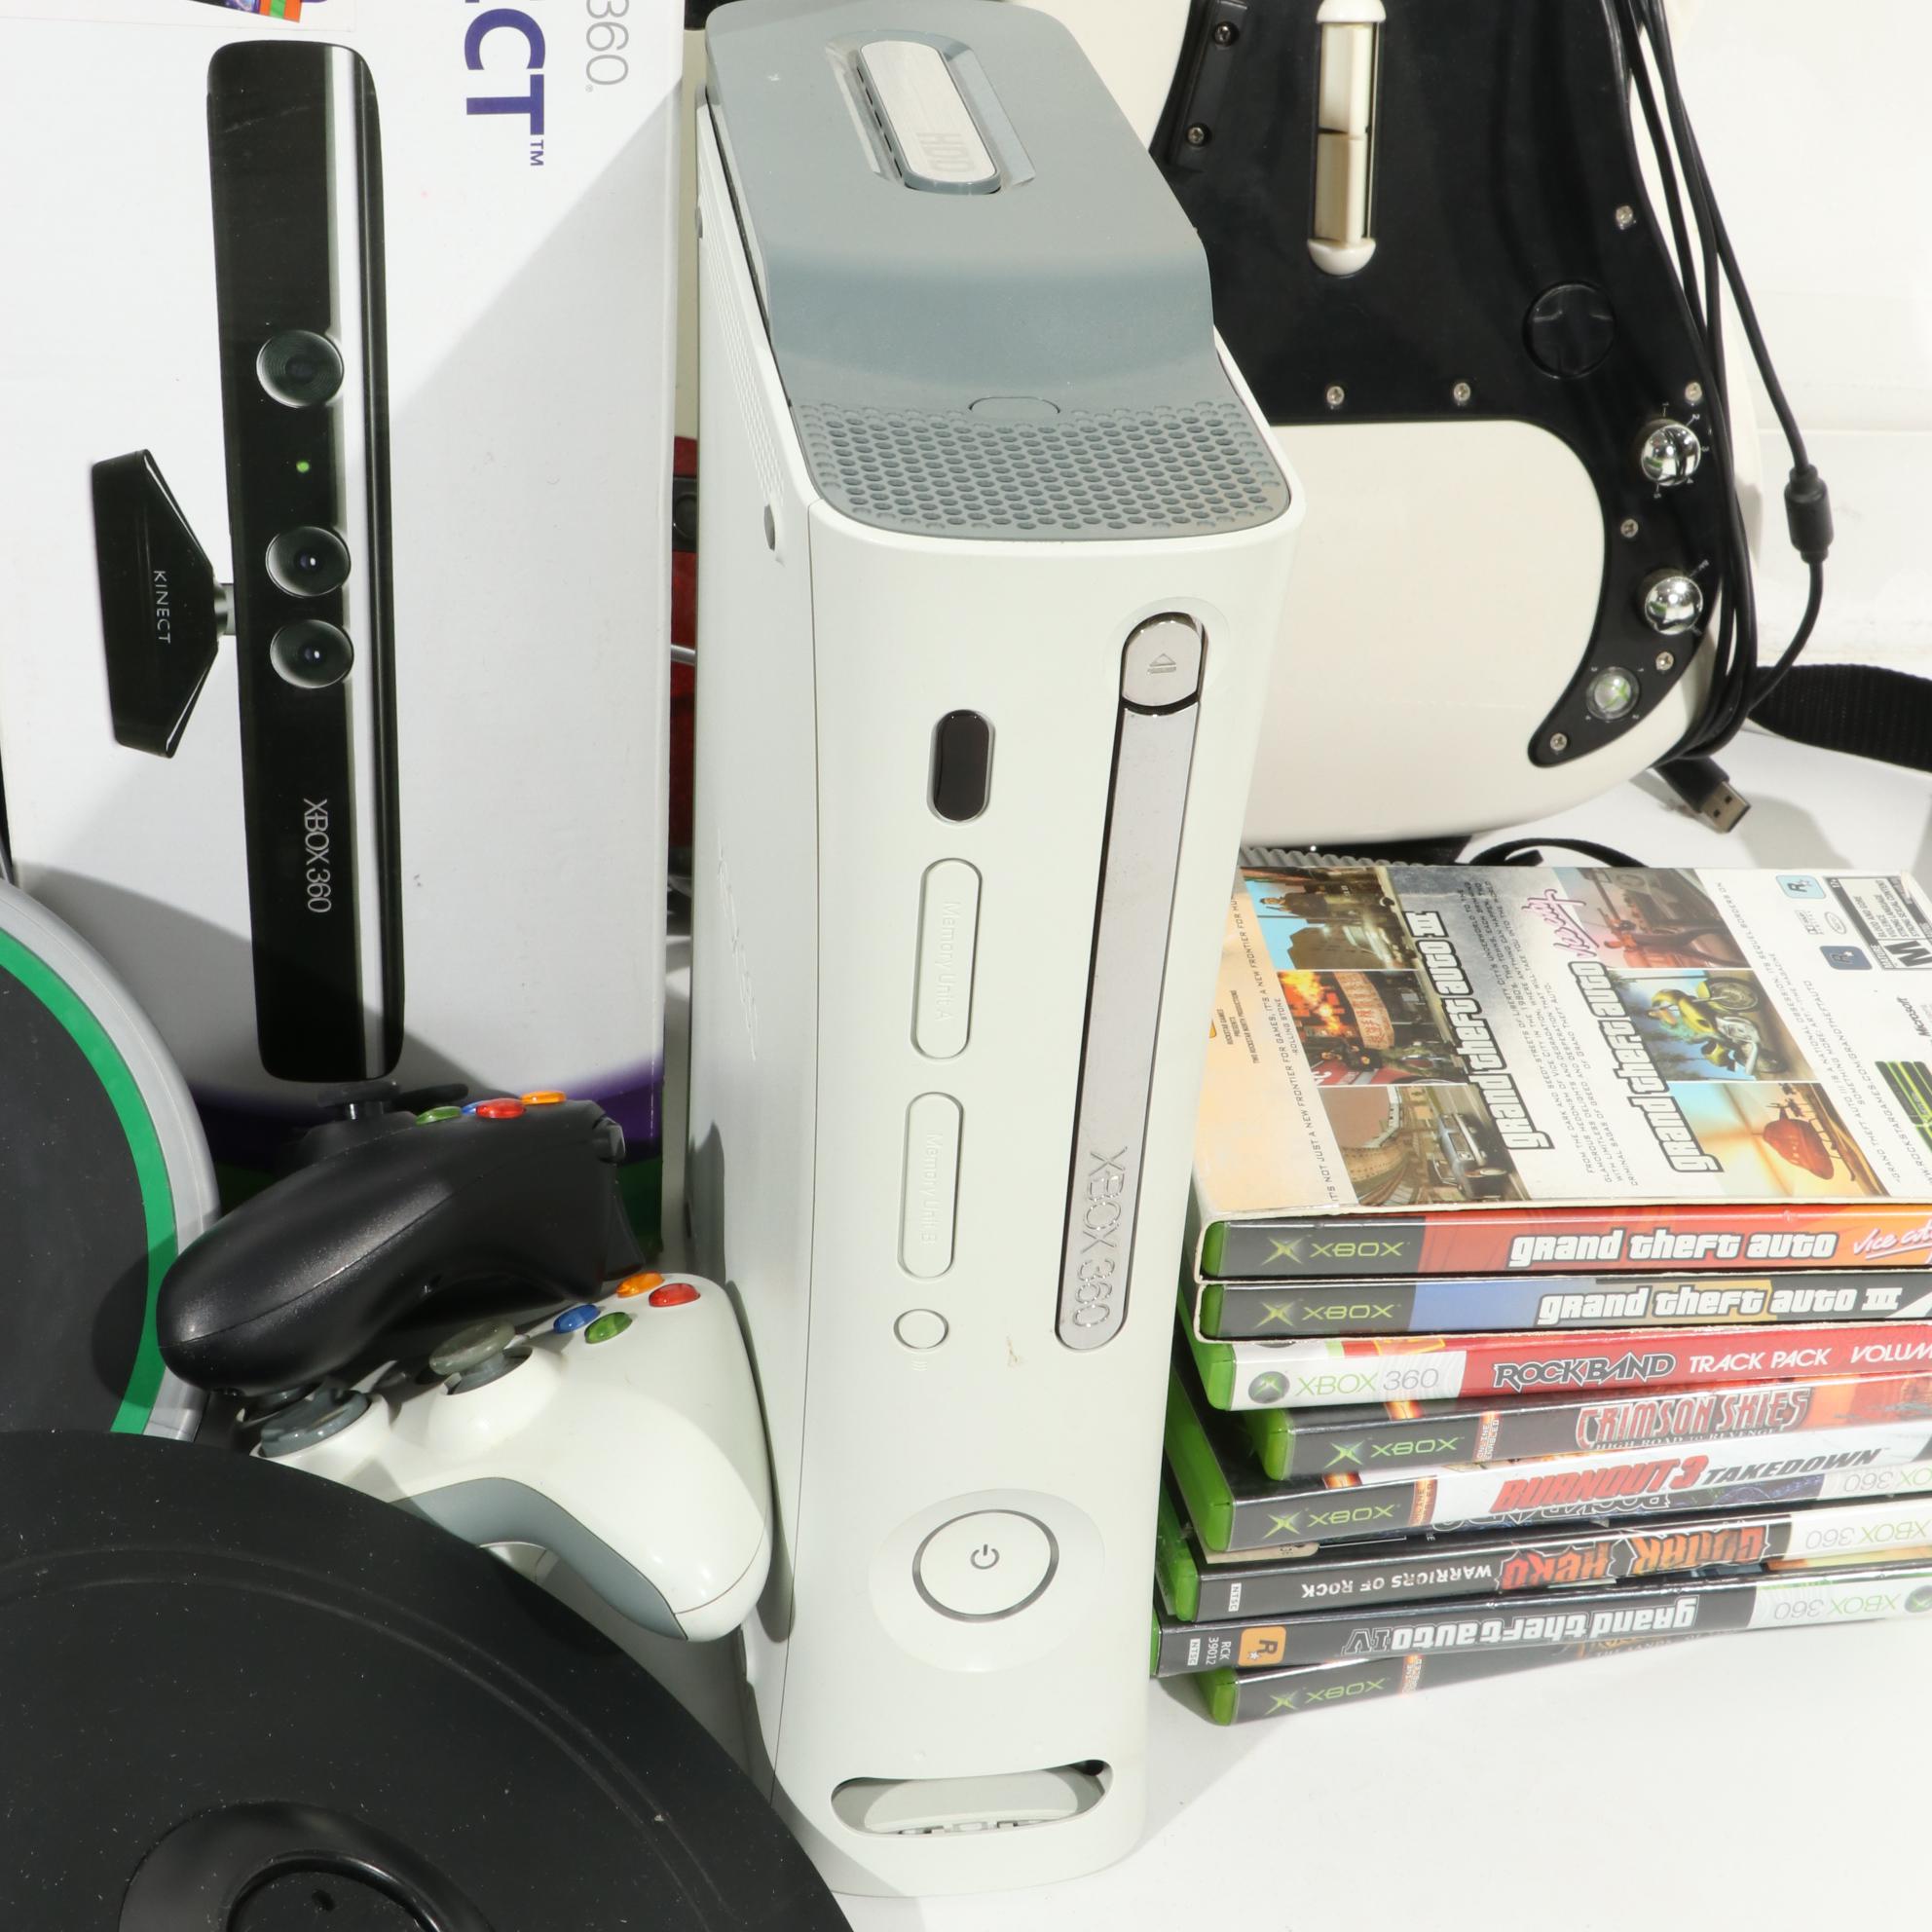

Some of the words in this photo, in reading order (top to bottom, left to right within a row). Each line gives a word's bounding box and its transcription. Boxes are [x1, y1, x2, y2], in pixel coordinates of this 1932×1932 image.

[464, 0, 545, 135] CT
[915, 132, 977, 172] HDD
[153, 570, 170, 644] KINECT
[304, 799, 329, 865] XBOX
[306, 868, 332, 913] 360
[937, 900, 962, 968] Memory
[1234, 913, 1245, 928] FOR
[1401, 910, 1449, 937] III
[1240, 931, 1257, 967] FRONTIER
[1883, 940, 1932, 967] M
[1253, 970, 1263, 985] NEW
[1413, 939, 1473, 994] auto
[936, 973, 958, 1005] Unit
[1262, 996, 1272, 1010] IT'S
[1566, 961, 1630, 1018] auto
[935, 1007, 954, 1022] A
[1274, 997, 1286, 1020] STONE
[1895, 996, 1930, 1035] Microsoft
[1268, 1013, 1284, 1043] GAMES,
[1434, 997, 1507, 1070] theft
[1279, 1046, 1289, 1061] FOR
[1588, 1020, 1671, 1094] theft
[1285, 1065, 1305, 1105] FRONTIER
[1301, 1109, 1313, 1127] NEW
[1467, 1073, 1554, 1149] grand
[1625, 1096, 1724, 1172] grand
[920, 1132, 943, 1196] Memory
[1311, 1140, 1324, 1161] JUST
[1319, 1165, 1331, 1181] NOT
[1072, 1146, 1128, 1253] XBOX
[1326, 1185, 1338, 1201] IT'S
[1310, 1242, 1404, 1258] XBOX
[1507, 1228, 1624, 1268] grand
[1628, 1228, 1744, 1260] theft
[1745, 1233, 1839, 1259] auto
[1072, 1257, 1116, 1329] 360
[1535, 1285, 1653, 1326] grand
[1653, 1285, 1767, 1316] theft
[1768, 1288, 1857, 1314] auto
[1861, 1287, 1903, 1311] III
[1302, 1304, 1394, 1319] XBOX
[1690, 1353, 1764, 1373] TRACK
[1770, 1348, 1832, 1369] PACK
[1294, 1373, 1379, 1397] XBOX
[1383, 1368, 1438, 1391] 360
[1575, 1393, 1718, 1450] CRIMSON
[1718, 1387, 1812, 1433] SKIES
[1370, 1437, 1460, 1458] XBOX
[1642, 1436, 1684, 1447] ROAD
[1709, 1428, 1776, 1440] REVENGE
[1491, 1458, 1680, 1512] BURNOUT
[1670, 1455, 1709, 1489] 3
[1700, 1449, 1882, 1486] TAKEDOWN
[1844, 1471, 1893, 1492] 360
[1307, 1505, 1394, 1528] XBOX
[1806, 1527, 1855, 1550] 360
[1858, 1520, 1931, 1543] XBOX
[1631, 1525, 1765, 1576] GUITAR
[1391, 1565, 1492, 1588] WARRIORS
[1501, 1542, 1609, 1590] HERO
[1229, 1584, 1242, 1611] NTSC
[1301, 1579, 1355, 1599] ROCK
[1359, 1577, 1385, 1592] OF
[1590, 1595, 1699, 1640] grand
[1774, 1600, 1825, 1621] 360
[1830, 1594, 1900, 1617] XBOX
[1342, 1627, 1391, 1655] IV
[1392, 1619, 1478, 1652] auto
[1479, 1613, 1589, 1644] theft
[1188, 1639, 1201, 1665] NTSC
[1206, 1637, 1219, 1665] 39012
[1219, 1641, 1232, 1660] RCK
[1306, 1677, 1386, 1704] XBOX
